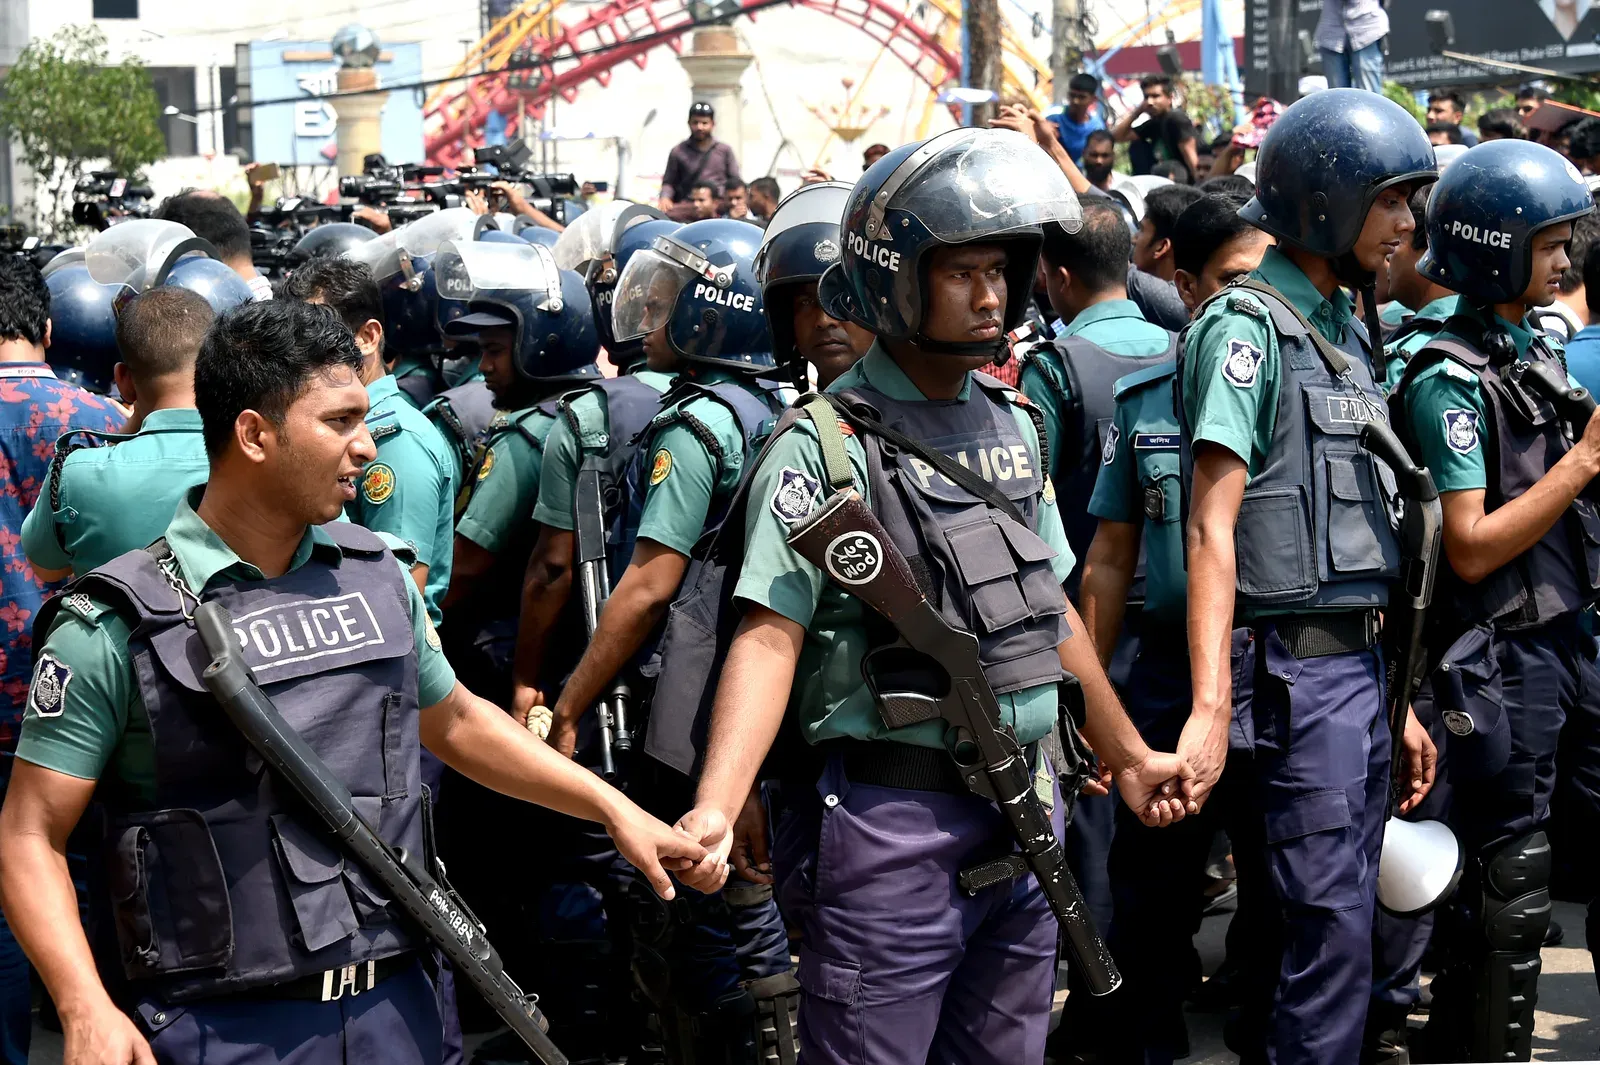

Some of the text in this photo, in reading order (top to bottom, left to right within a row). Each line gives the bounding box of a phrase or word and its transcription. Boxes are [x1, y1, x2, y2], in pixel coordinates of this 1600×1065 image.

[1452, 220, 1512, 249] POLICE
[848, 230, 901, 272] POLICE
[694, 283, 755, 312] POLICE
[843, 551, 876, 578] POM
